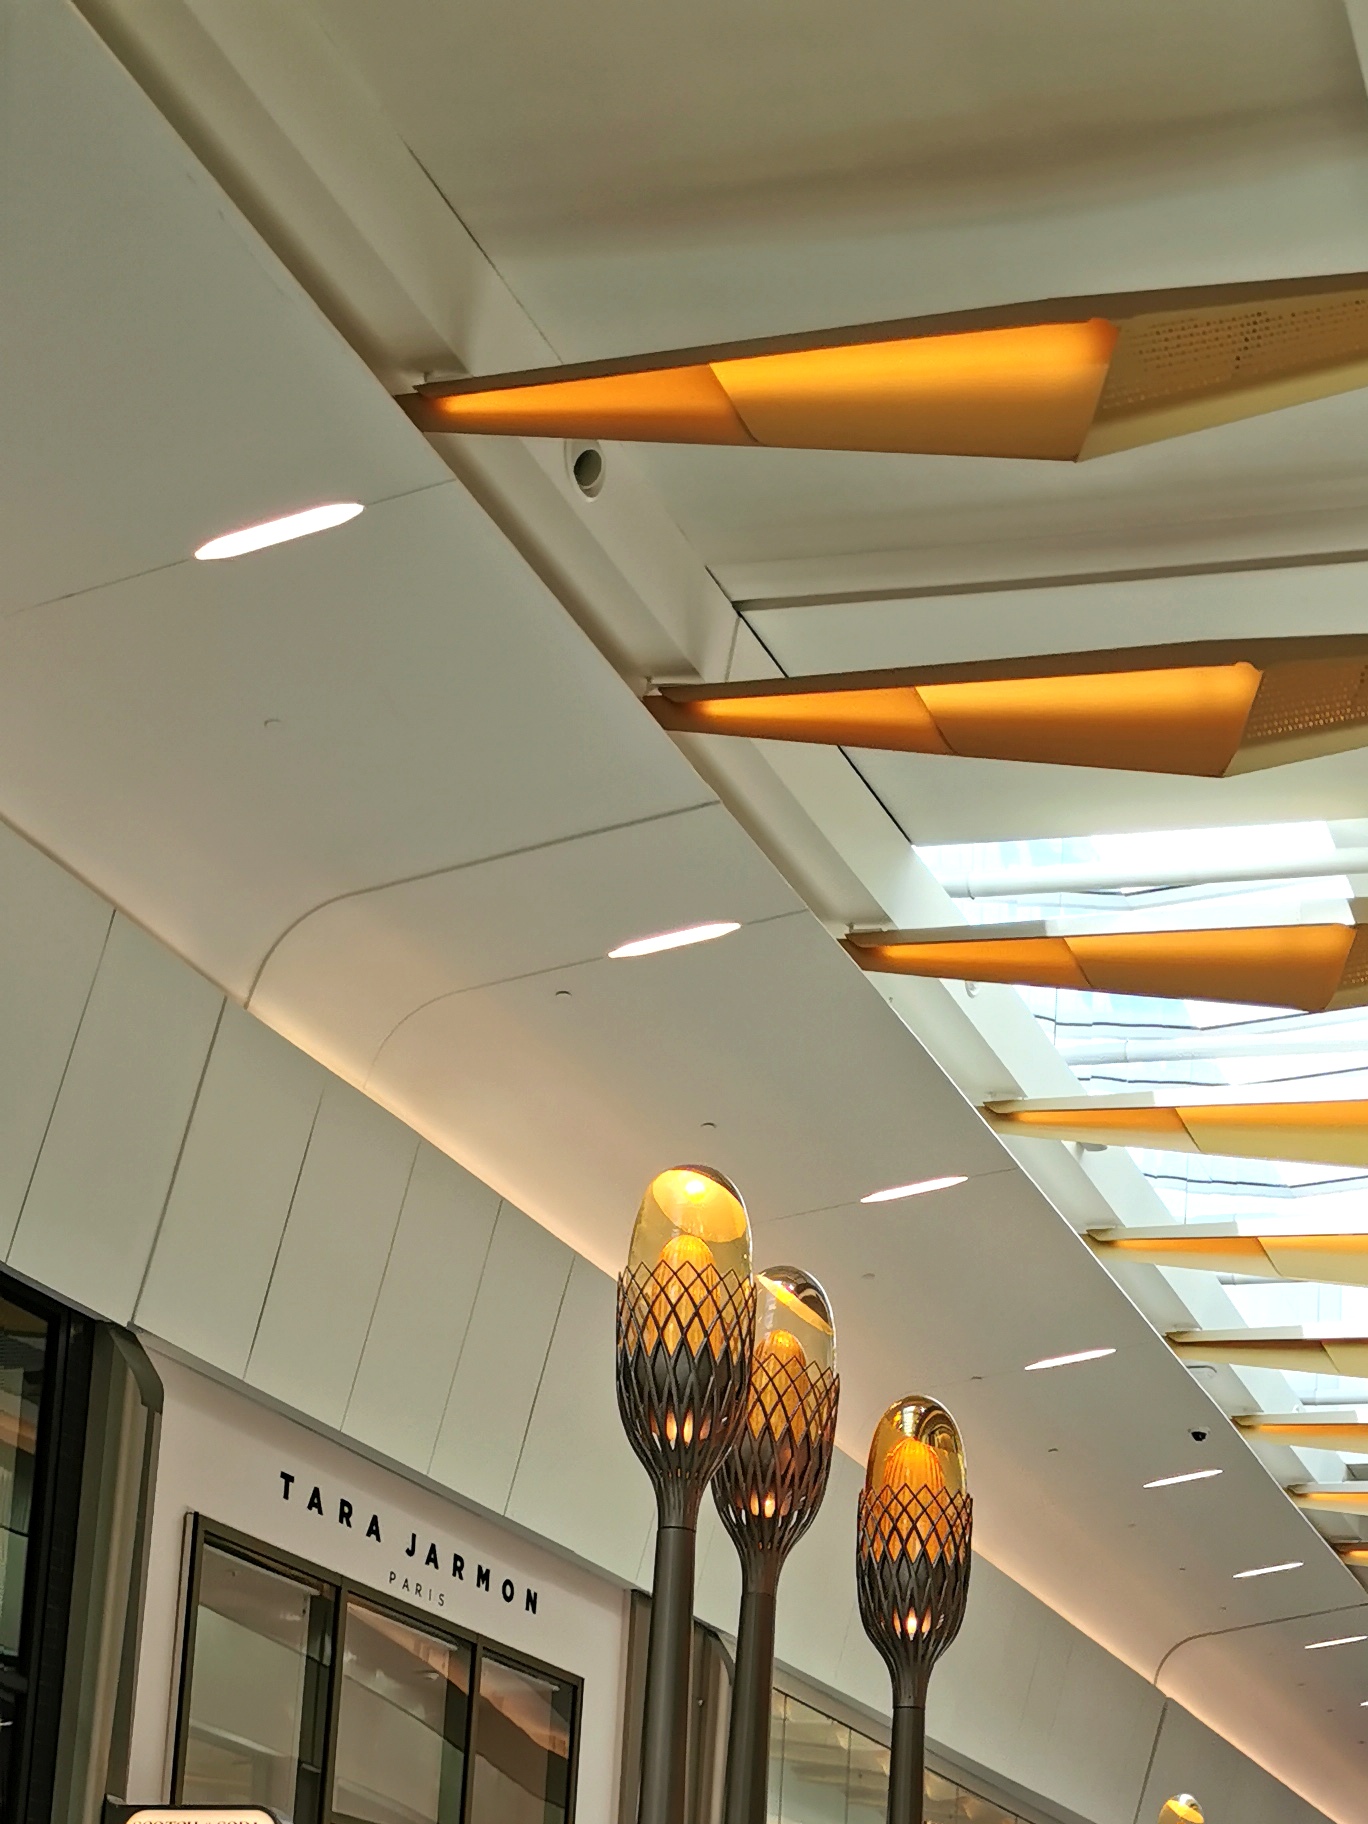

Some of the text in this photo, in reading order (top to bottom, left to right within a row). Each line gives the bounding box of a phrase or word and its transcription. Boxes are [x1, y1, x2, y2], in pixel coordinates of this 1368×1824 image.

[280, 1471, 537, 1614] TARA JARMON
[389, 1571, 445, 1607] PARIS
